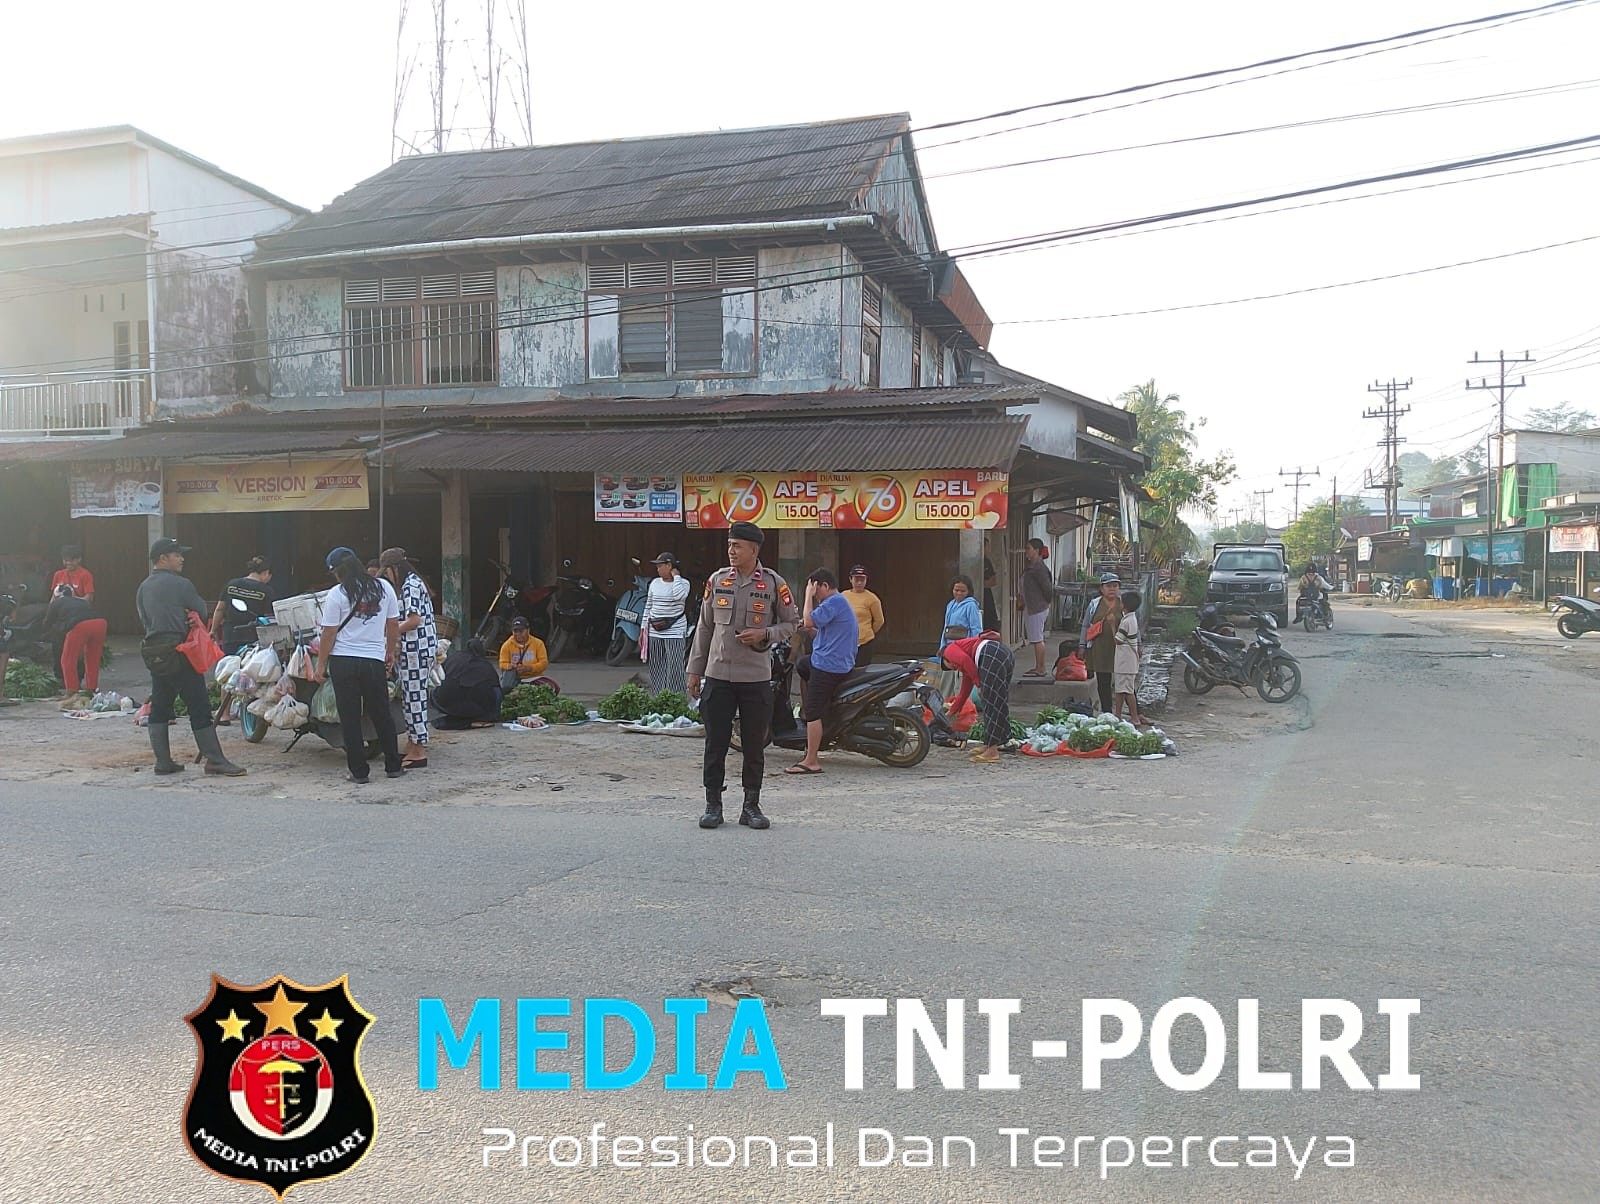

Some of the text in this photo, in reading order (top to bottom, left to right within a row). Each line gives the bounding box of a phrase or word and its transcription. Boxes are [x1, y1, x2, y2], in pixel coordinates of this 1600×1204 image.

[820, 474, 851, 482] DJARUM
[977, 471, 1007, 482] BARU
[233, 476, 306, 494] VERSION
[775, 481, 818, 497] APE
[915, 480, 975, 496] APEL
[725, 479, 758, 520] 76
[860, 478, 897, 521] 76
[784, 505, 818, 518] 15.00
[925, 504, 970, 518] 15.000
[749, 591, 771, 600] POLRI
